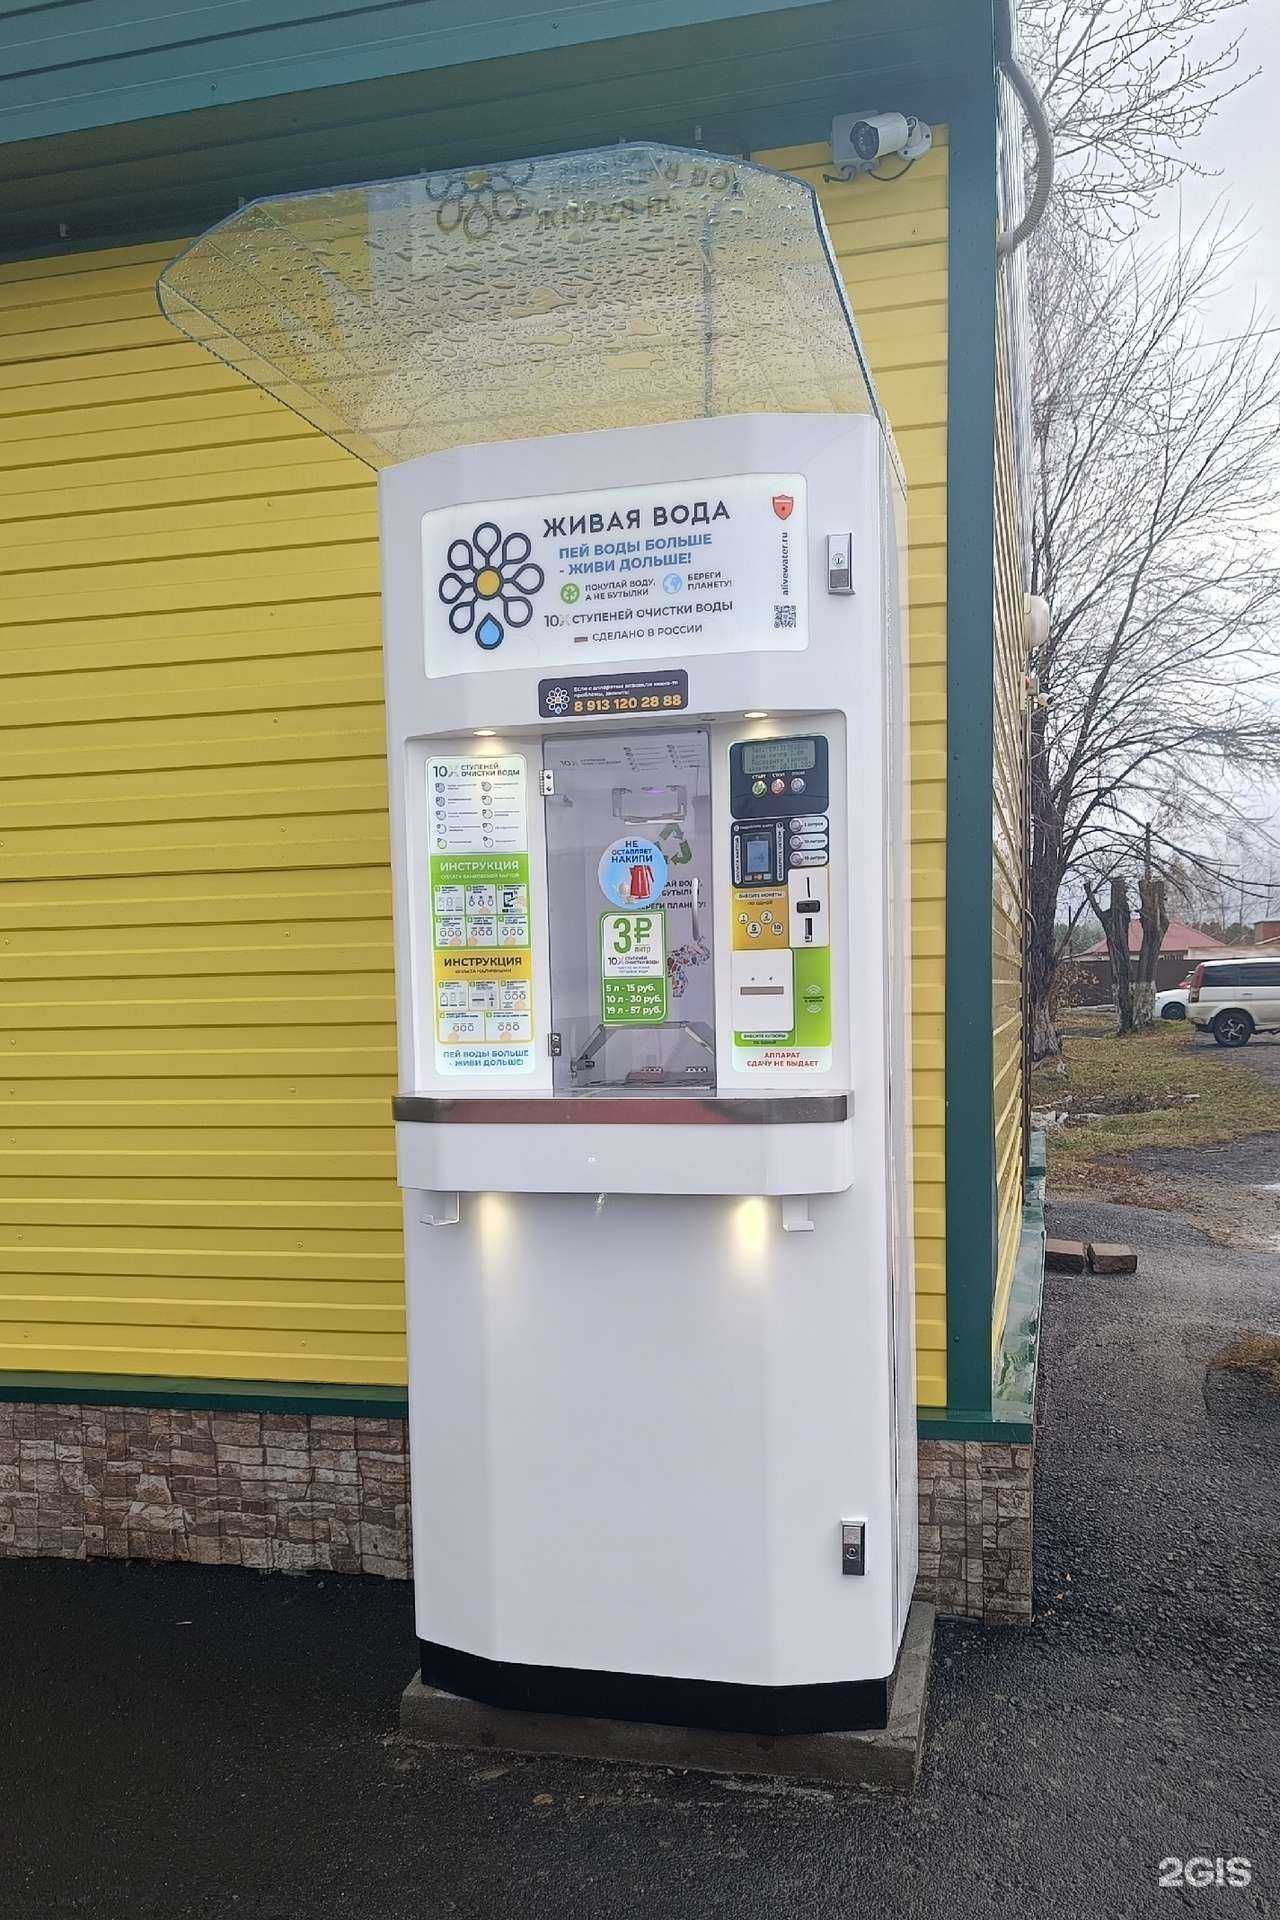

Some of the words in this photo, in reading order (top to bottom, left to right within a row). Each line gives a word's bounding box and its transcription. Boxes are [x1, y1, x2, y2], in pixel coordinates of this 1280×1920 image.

[543, 509, 640, 538] ЖИВАЯ
[653, 500, 730, 527] ВОДА
[559, 545, 589, 559] ПЕЙ
[594, 541, 640, 556] ВОДЫ
[645, 533, 712, 550] БОЛЬШЕ
[568, 559, 615, 575] ЖИВИ
[619, 552, 692, 572] ДОЛЬШЕ!
[780, 532, 789, 596] alivewater.ru
[687, 571, 721, 581] БЕРЕГИ
[585, 580, 628, 592] ПОКУПАЙ
[630, 579, 655, 588] ВОДУ,
[688, 580, 732, 590] ПЛАНЕТУ!
[594, 592, 605, 600] НЕ
[607, 588, 649, 600] БУТЫЛКИ
[572, 609, 633, 624] СТУПЕНЕЙ
[637, 604, 692, 618] ОЧИСТКИ
[695, 601, 733, 613] ВОДЫ
[592, 629, 645, 642] СДЕЛАНО
[648, 628, 654, 636] В
[657, 624, 703, 635] РОССИИ
[574, 701, 583, 712] 8
[586, 700, 610, 711] 913
[614, 697, 638, 709] 120
[641, 696, 659, 708] 28
[663, 694, 682, 706] 88
[461, 762, 499, 770] СТУПЕНЕЙ
[433, 766, 448, 778] 10
[625, 840, 638, 848] НЕ
[612, 848, 652, 856] ОСТАВЛЯЕТ
[611, 855, 653, 863] НАКИПИ
[440, 861, 519, 871] ИНСТРУКЦИЯ
[444, 957, 522, 967] ИНСТРУКЦИЯ
[608, 957, 618, 965] 10
[637, 984, 656, 994] руб.
[630, 995, 642, 1003] 30
[643, 995, 662, 1005] руб.
[643, 1006, 661, 1017] руб.
[443, 1050, 461, 1058] ПЕЙ
[463, 1050, 490, 1058] ВОДЫ
[455, 1059, 481, 1067] ЖИВИ
